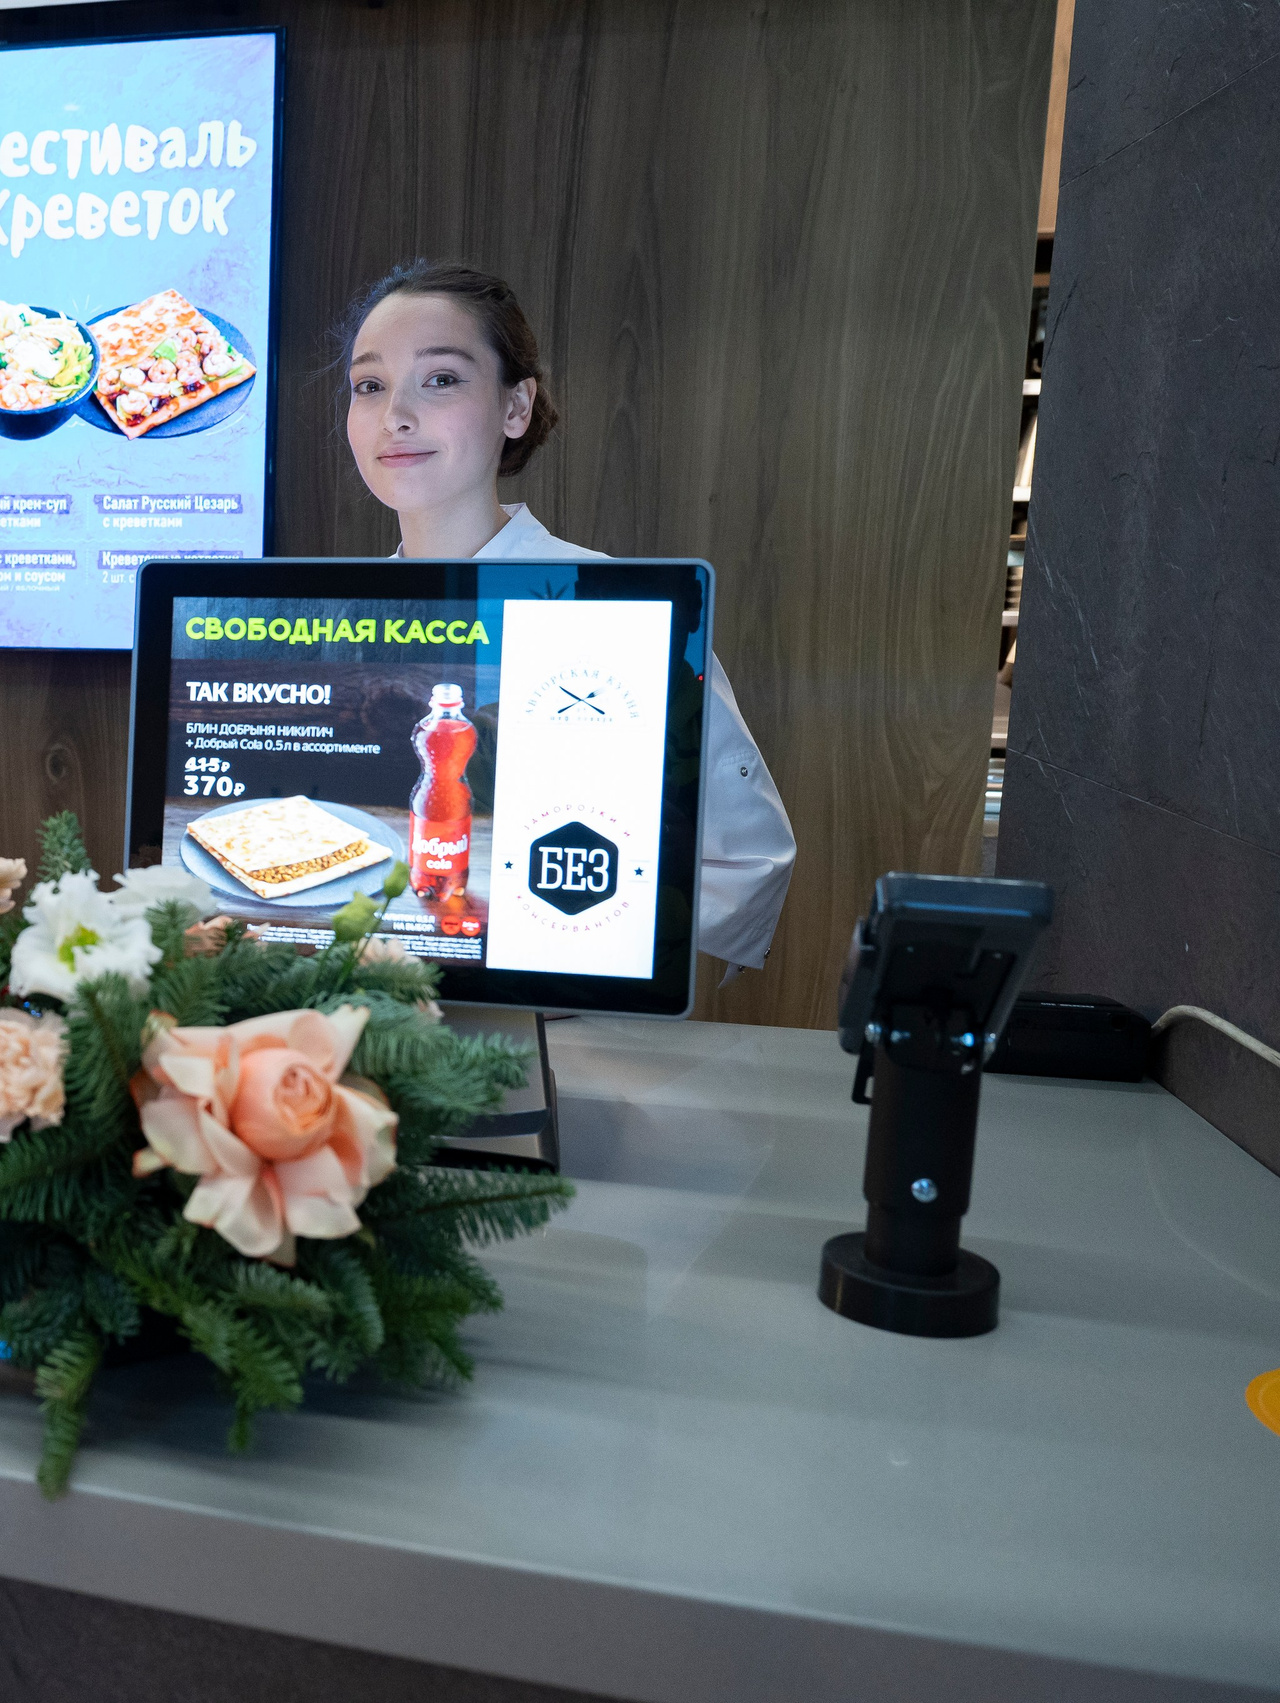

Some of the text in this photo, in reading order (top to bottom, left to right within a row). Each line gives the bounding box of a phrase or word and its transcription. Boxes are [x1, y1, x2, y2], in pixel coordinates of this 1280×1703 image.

[102, 494, 239, 514] Салат Русский Цезарь
[102, 516, 183, 531] с креветками
[5, 553, 77, 569] креветками,
[14, 570, 22, 582] и
[24, 569, 67, 585] соусом
[102, 571, 108, 584] 2
[110, 573, 126, 584] шт.
[185, 616, 490, 645] СВОБОДНАЯ КАССА
[185, 681, 332, 705] ТАК ВКУСНО!
[185, 722, 334, 738] БЛИН ДОБРЫНЯ НИКИТИЧ
[194, 737, 238, 751] Добрый
[239, 738, 263, 751] Cola
[293, 742, 300, 752] в
[301, 742, 381, 755] ассортименте
[536, 846, 610, 893] БЕЗ
